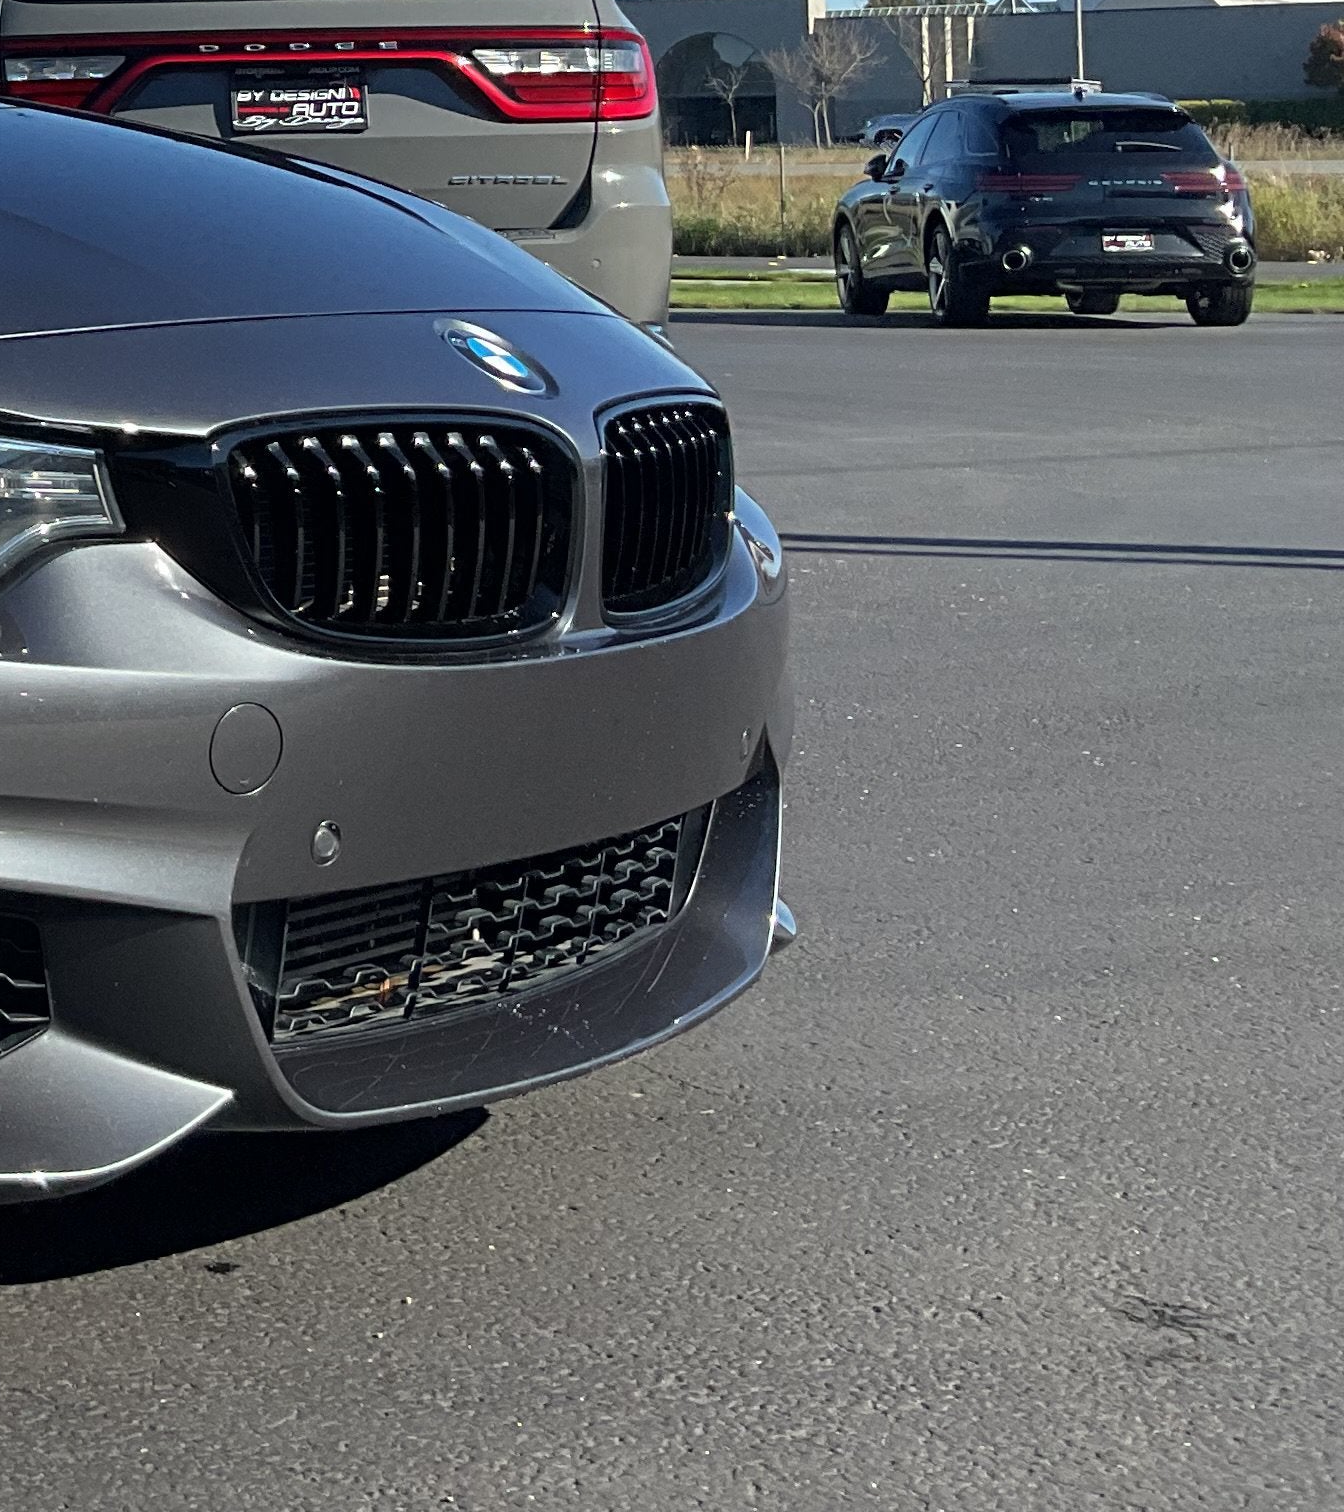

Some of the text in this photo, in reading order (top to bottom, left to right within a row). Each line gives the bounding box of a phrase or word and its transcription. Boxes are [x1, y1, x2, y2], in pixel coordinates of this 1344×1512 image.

[198, 40, 399, 53] DODGE
[236, 88, 341, 102] BY DESIGN
[291, 101, 360, 117] AUTO
